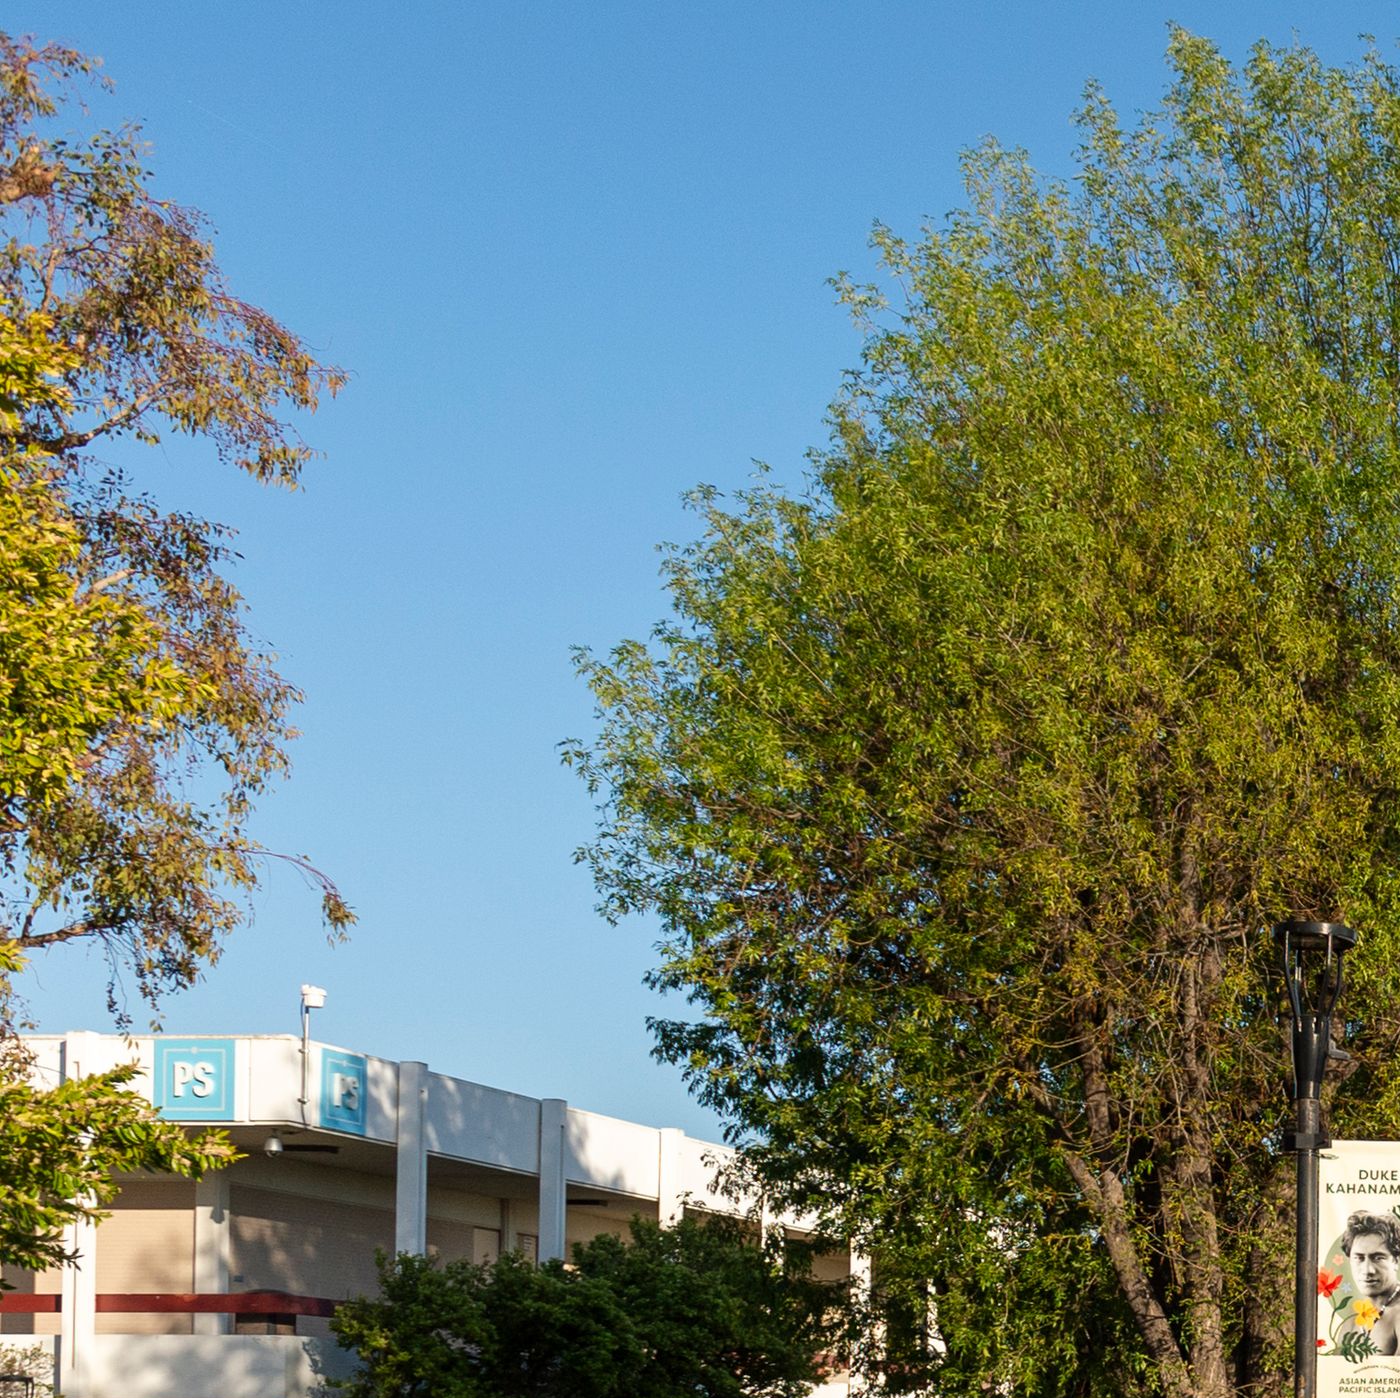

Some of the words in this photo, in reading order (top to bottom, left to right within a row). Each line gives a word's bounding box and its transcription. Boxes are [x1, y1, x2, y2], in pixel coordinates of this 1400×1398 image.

[173, 1061, 216, 1098] PS
[333, 1072, 359, 1110] PS
[1358, 1169, 1398, 1181] DUKE
